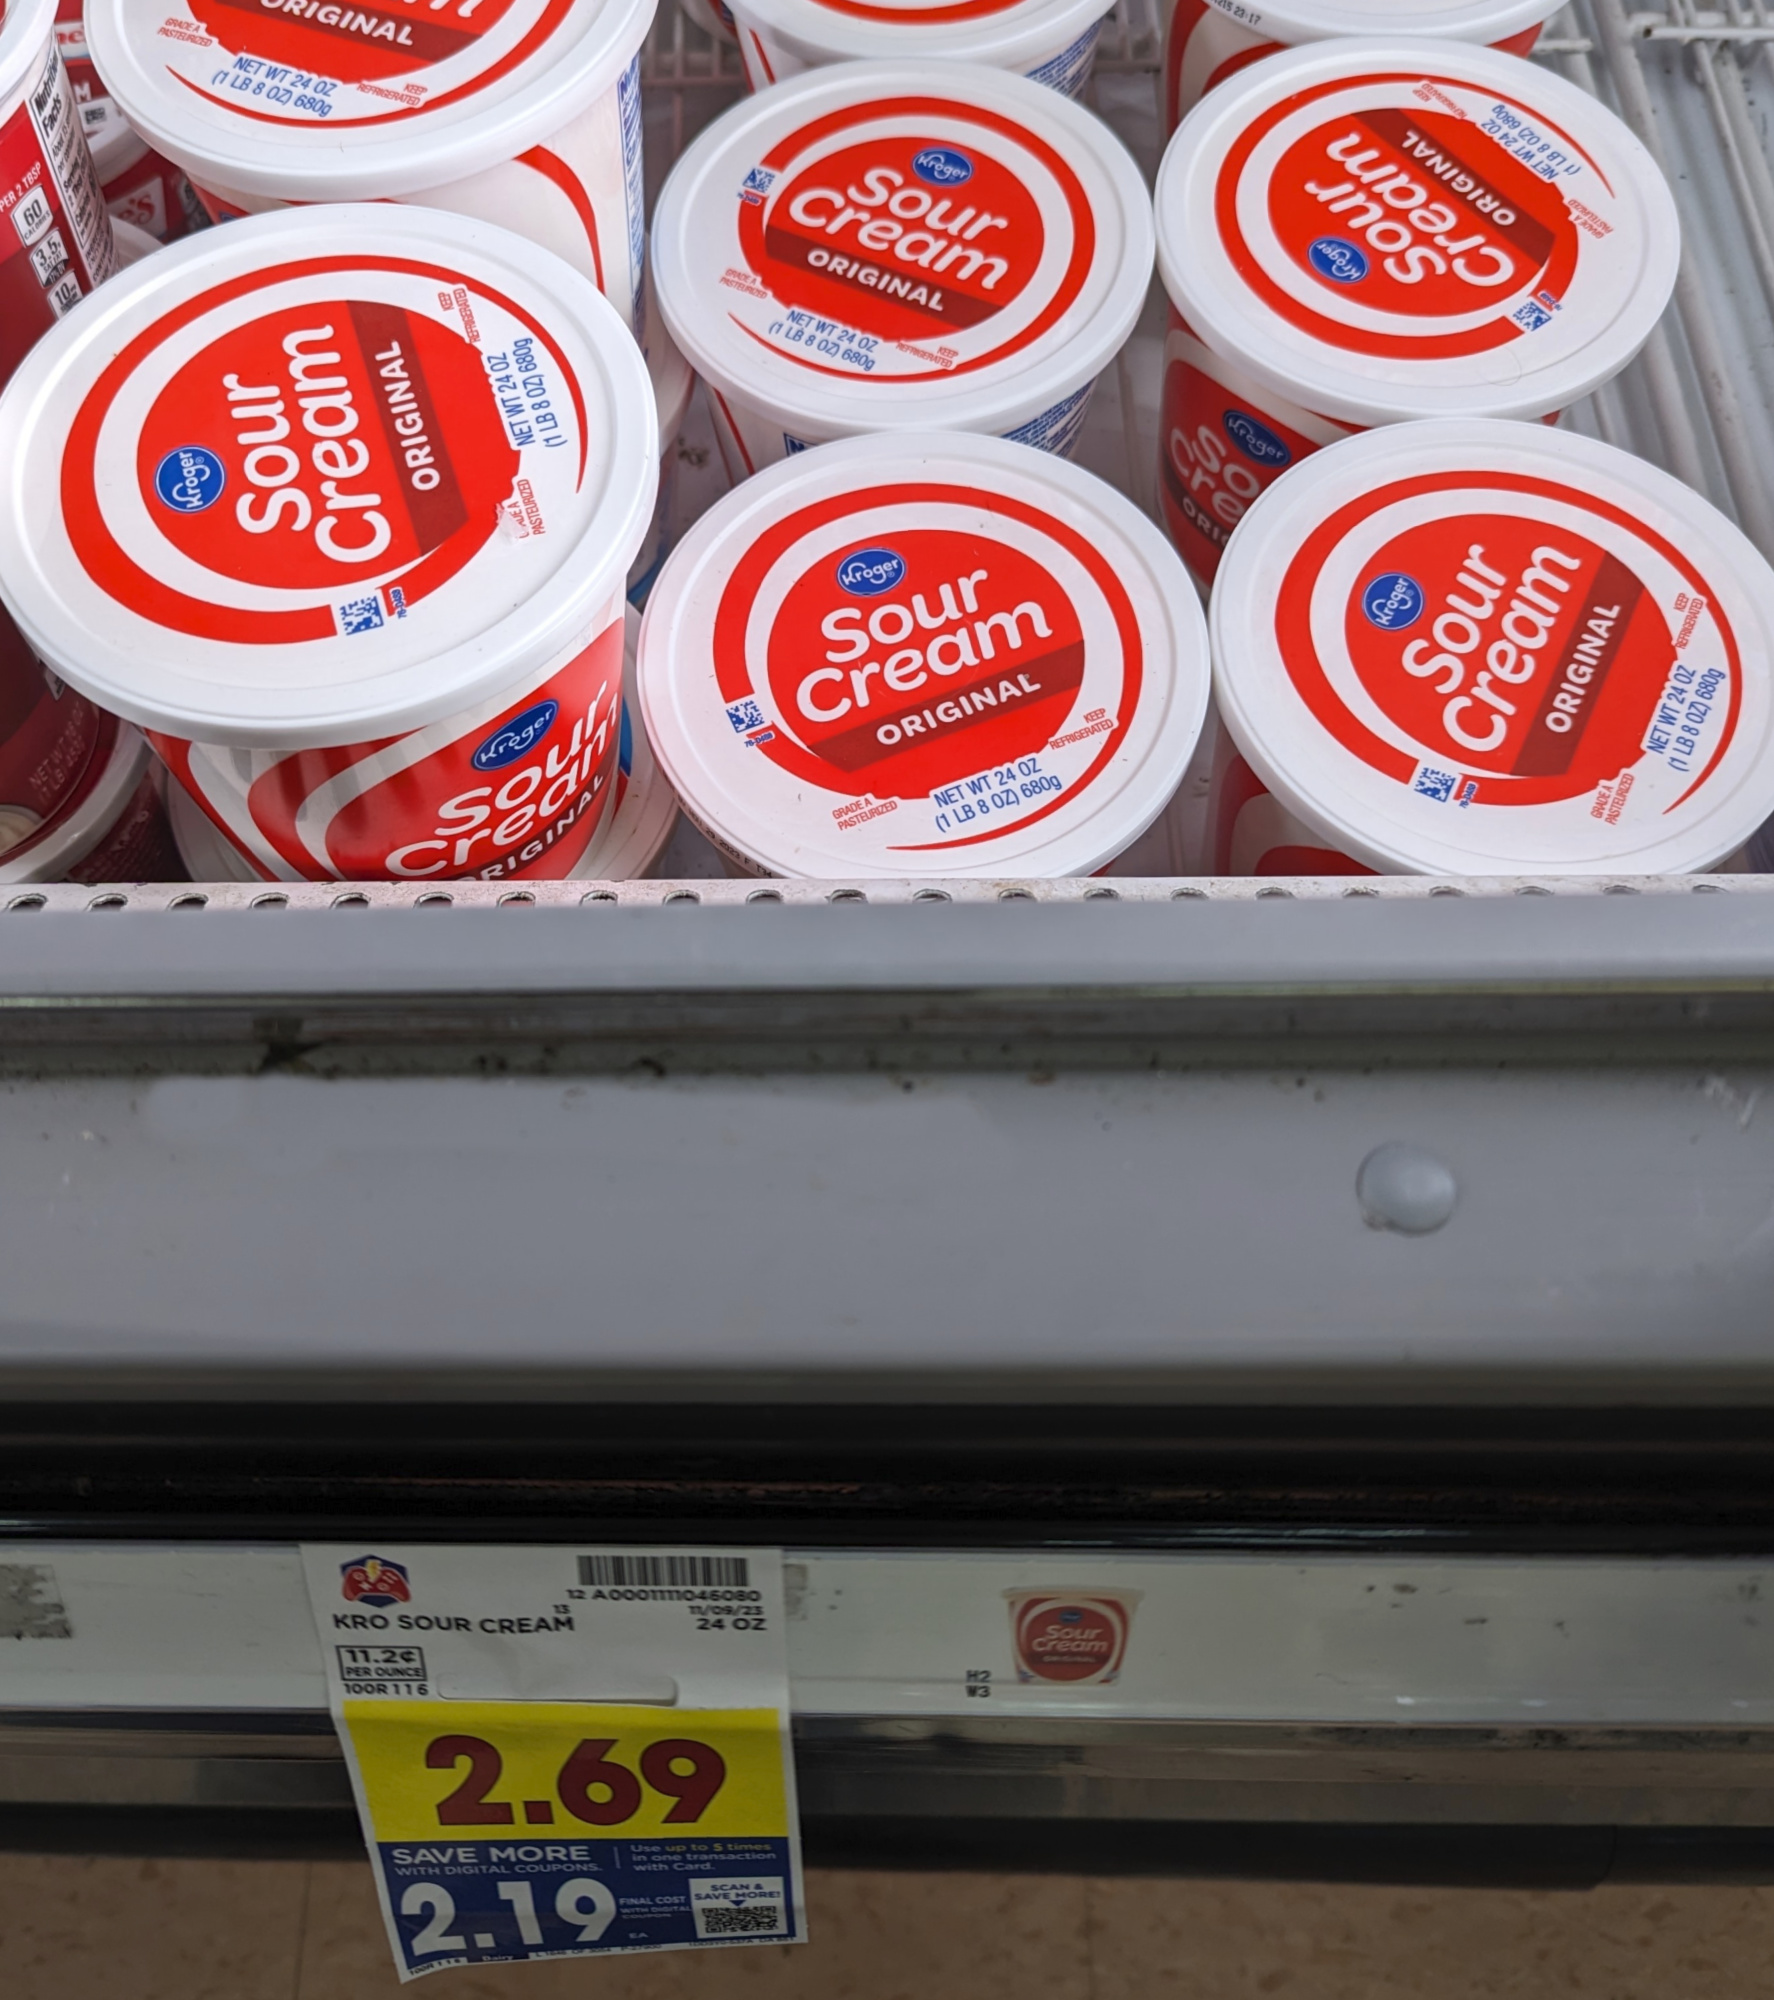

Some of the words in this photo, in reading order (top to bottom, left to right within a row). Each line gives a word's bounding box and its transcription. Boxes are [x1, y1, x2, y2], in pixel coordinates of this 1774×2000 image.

[158, 27, 212, 47] PASTEURIZED
[165, 18, 191, 30] GRADE
[233, 56, 266, 75] NET
[265, 64, 290, 83] WT
[290, 73, 310, 90] 24
[314, 80, 337, 98] OZ
[404, 82, 428, 97] KEEP
[211, 70, 230, 86] (1
[230, 73, 251, 91] LB
[252, 81, 264, 95] 8
[266, 84, 293, 105] OZ)
[294, 94, 333, 118] 680g
[356, 82, 421, 108] REFRIGERATED
[1480, 118, 1500, 135] OZ
[1492, 104, 1521, 129] 680g
[1499, 132, 1518, 147] 24
[1520, 126, 1541, 144] OZ)
[1513, 146, 1536, 164] WT
[1538, 144, 1550, 153] 8
[1547, 150, 1568, 167] LB
[918, 154, 968, 180] Kroger
[1402, 130, 1516, 226] ORIGINAL
[1530, 159, 1559, 180] NET
[1564, 164, 1582, 176] (1
[0, 191, 16, 212] PER
[22, 162, 42, 188] TBSP
[23, 199, 42, 227] 60
[847, 168, 1008, 240] Sour
[1326, 133, 1514, 287] Cream
[790, 188, 1008, 290] Cream
[1304, 180, 1447, 284] Sour
[1316, 242, 1361, 280] Kroger
[720, 276, 768, 300] PASTEURIZED
[808, 250, 944, 312] ORIGINAL
[438, 291, 454, 311] KEEP
[453, 288, 480, 344] REFRIGERATED
[786, 310, 815, 328] NET
[814, 318, 838, 337] WT
[837, 329, 857, 345] 24
[858, 336, 879, 354] OZ
[513, 338, 538, 373] 680g
[768, 320, 782, 336] (1
[784, 326, 802, 342] LB
[804, 334, 817, 347] 8
[817, 338, 841, 358] OZ)
[841, 348, 876, 372] 680g
[937, 346, 959, 359] KEEP
[486, 352, 509, 372] OZ
[495, 374, 517, 392] 24
[522, 374, 546, 398] OZ)
[375, 340, 441, 491] ORIGINAL
[500, 394, 524, 420] WT
[530, 400, 551, 410] 8
[509, 420, 536, 447] NET
[536, 413, 558, 433] LB
[282, 324, 392, 562] Cream
[542, 434, 568, 448] (1
[1228, 418, 1284, 459] Kroger
[222, 373, 312, 534] Sour
[1192, 425, 1260, 498] So
[171, 451, 211, 508] Kroger
[1170, 428, 1248, 524] Cre
[516, 478, 546, 536] PASTEURIZED
[841, 558, 899, 586] Kroger
[1371, 577, 1412, 626] Kroger
[1673, 592, 1689, 613] KEEP
[820, 569, 989, 664] Sour
[1402, 544, 1508, 694] Sour
[1674, 598, 1704, 650] REFRIGERATED
[796, 601, 1054, 723] Cream
[1442, 546, 1581, 752] Cream
[1544, 604, 1621, 733] ORIGINAL
[1673, 664, 1697, 684] OZ
[1666, 686, 1688, 706] 24
[1694, 668, 1727, 701] 680g
[876, 674, 1042, 746] ORIGINAL
[1083, 708, 1107, 724] KEEP
[1657, 703, 1681, 727] WT
[1685, 700, 1712, 725] OZ)
[480, 708, 553, 763] Kroger
[1048, 718, 1114, 750] REFRIGERATED
[1646, 724, 1672, 755] NET
[1680, 724, 1700, 737] 8
[434, 680, 608, 836] Sour
[1672, 735, 1695, 756] LB
[1667, 756, 1690, 772] (1
[385, 692, 618, 876] Cream
[934, 785, 964, 808] NET
[964, 775, 993, 797] WT
[994, 766, 1016, 786] 24
[1018, 758, 1042, 778] OZ
[832, 800, 864, 820] GRADE
[864, 797, 873, 808] A
[934, 812, 952, 832] (1
[953, 803, 976, 824] LB
[976, 798, 990, 815] 8
[991, 788, 1021, 809] OZ)
[1021, 774, 1062, 800] 680g
[1590, 792, 1612, 819] GRADE
[1604, 772, 1635, 826] PASTEURIZED
[461, 775, 604, 880] RIGINAL
[837, 800, 898, 831] PASTEURIZED
[566, 1588, 586, 1600] 12
[332, 1614, 390, 1630] KRO
[398, 1615, 472, 1632] SOUR
[479, 1616, 575, 1634] CREAM
[696, 1618, 726, 1630] 24
[732, 1618, 768, 1630] OZ
[1046, 1624, 1104, 1640] Sour
[345, 1648, 418, 1664] 11.2¢
[1032, 1638, 1108, 1652] Cream
[345, 1666, 372, 1678] PER
[374, 1666, 424, 1678] OUNCE
[966, 1670, 992, 1684] H2
[424, 1734, 726, 1826] 2.69
[392, 1846, 478, 1865] SAVE
[490, 1845, 592, 1862] MORE
[630, 1844, 662, 1852] Use
[664, 1844, 687, 1853] up
[690, 1844, 710, 1852] to
[713, 1843, 724, 1852] 5
[727, 1842, 772, 1852] times
[632, 1854, 648, 1862] in
[651, 1853, 683, 1862] one
[686, 1852, 777, 1861] transaction
[394, 1866, 440, 1876] WITH
[444, 1864, 510, 1875] DIGITAL
[514, 1862, 604, 1874] COUPONS.
[633, 1862, 669, 1872] with
[672, 1862, 716, 1871] Card.
[620, 1897, 654, 1905] FINAL
[655, 1896, 686, 1904] COST
[694, 1892, 731, 1900] SAVE
[734, 1891, 780, 1900] MORE!
[710, 1884, 750, 1892] SCAN
[401, 1878, 617, 1958] 2.19
[620, 1906, 648, 1914] WITH
[651, 1906, 692, 1914] DIGITAL
[628, 1932, 648, 1940] EA
